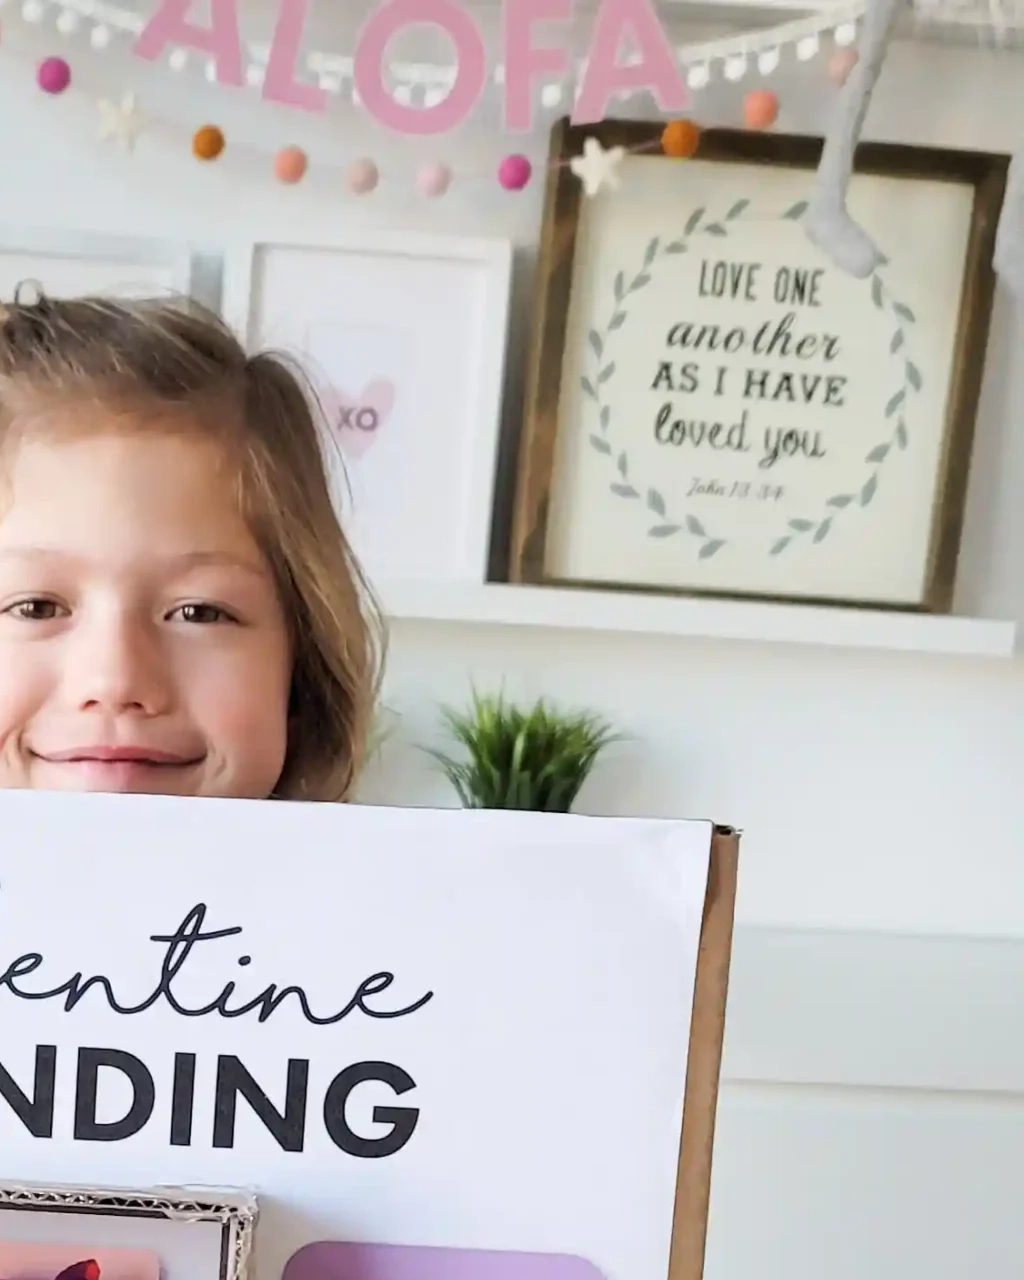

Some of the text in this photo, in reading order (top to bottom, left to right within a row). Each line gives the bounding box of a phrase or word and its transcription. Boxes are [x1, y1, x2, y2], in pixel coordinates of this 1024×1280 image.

[132, 0, 687, 136] ALOFA
[699, 259, 825, 307] LOVE ONE
[666, 312, 841, 362] another
[650, 361, 848, 407] AS I HAVE
[654, 401, 826, 469] loved you
